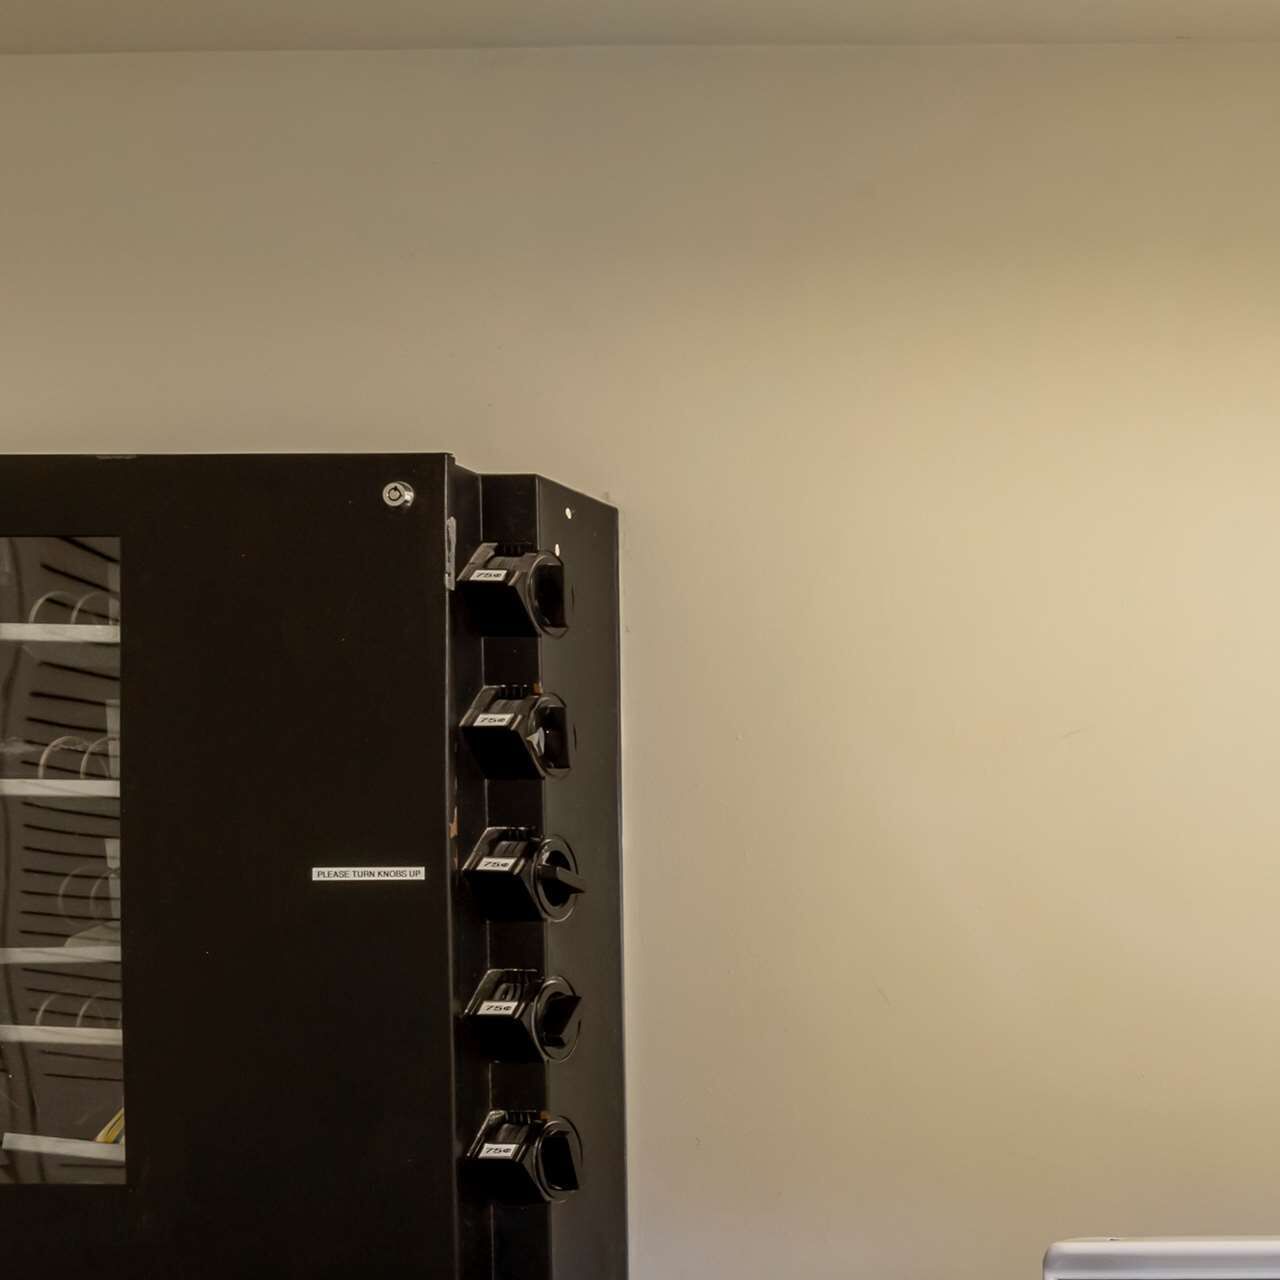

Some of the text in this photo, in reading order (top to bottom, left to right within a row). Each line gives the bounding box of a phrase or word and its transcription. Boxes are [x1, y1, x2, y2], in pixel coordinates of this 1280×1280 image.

[317, 869, 421, 879] PLEASE TURN KNOBS UP
